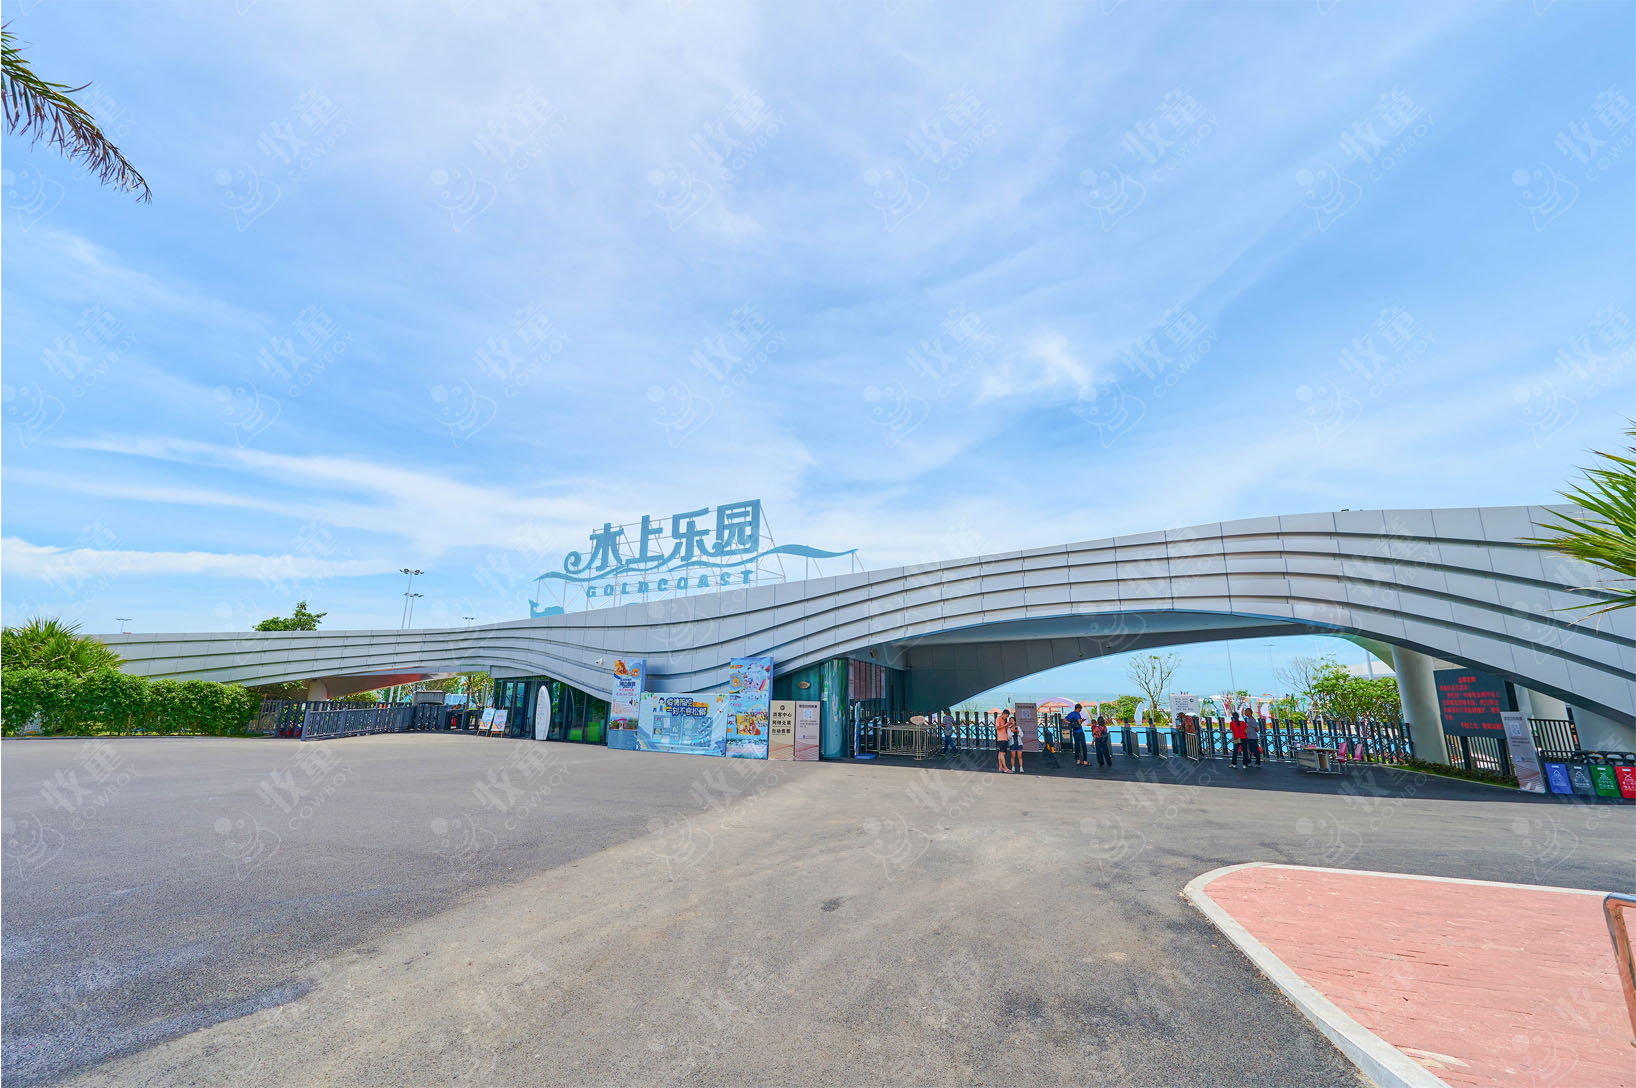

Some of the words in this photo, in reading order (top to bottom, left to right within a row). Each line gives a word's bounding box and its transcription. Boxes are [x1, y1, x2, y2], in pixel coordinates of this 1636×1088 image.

[564, 499, 760, 574] 水上乐园
[586, 570, 754, 597] GOLDCOAST
